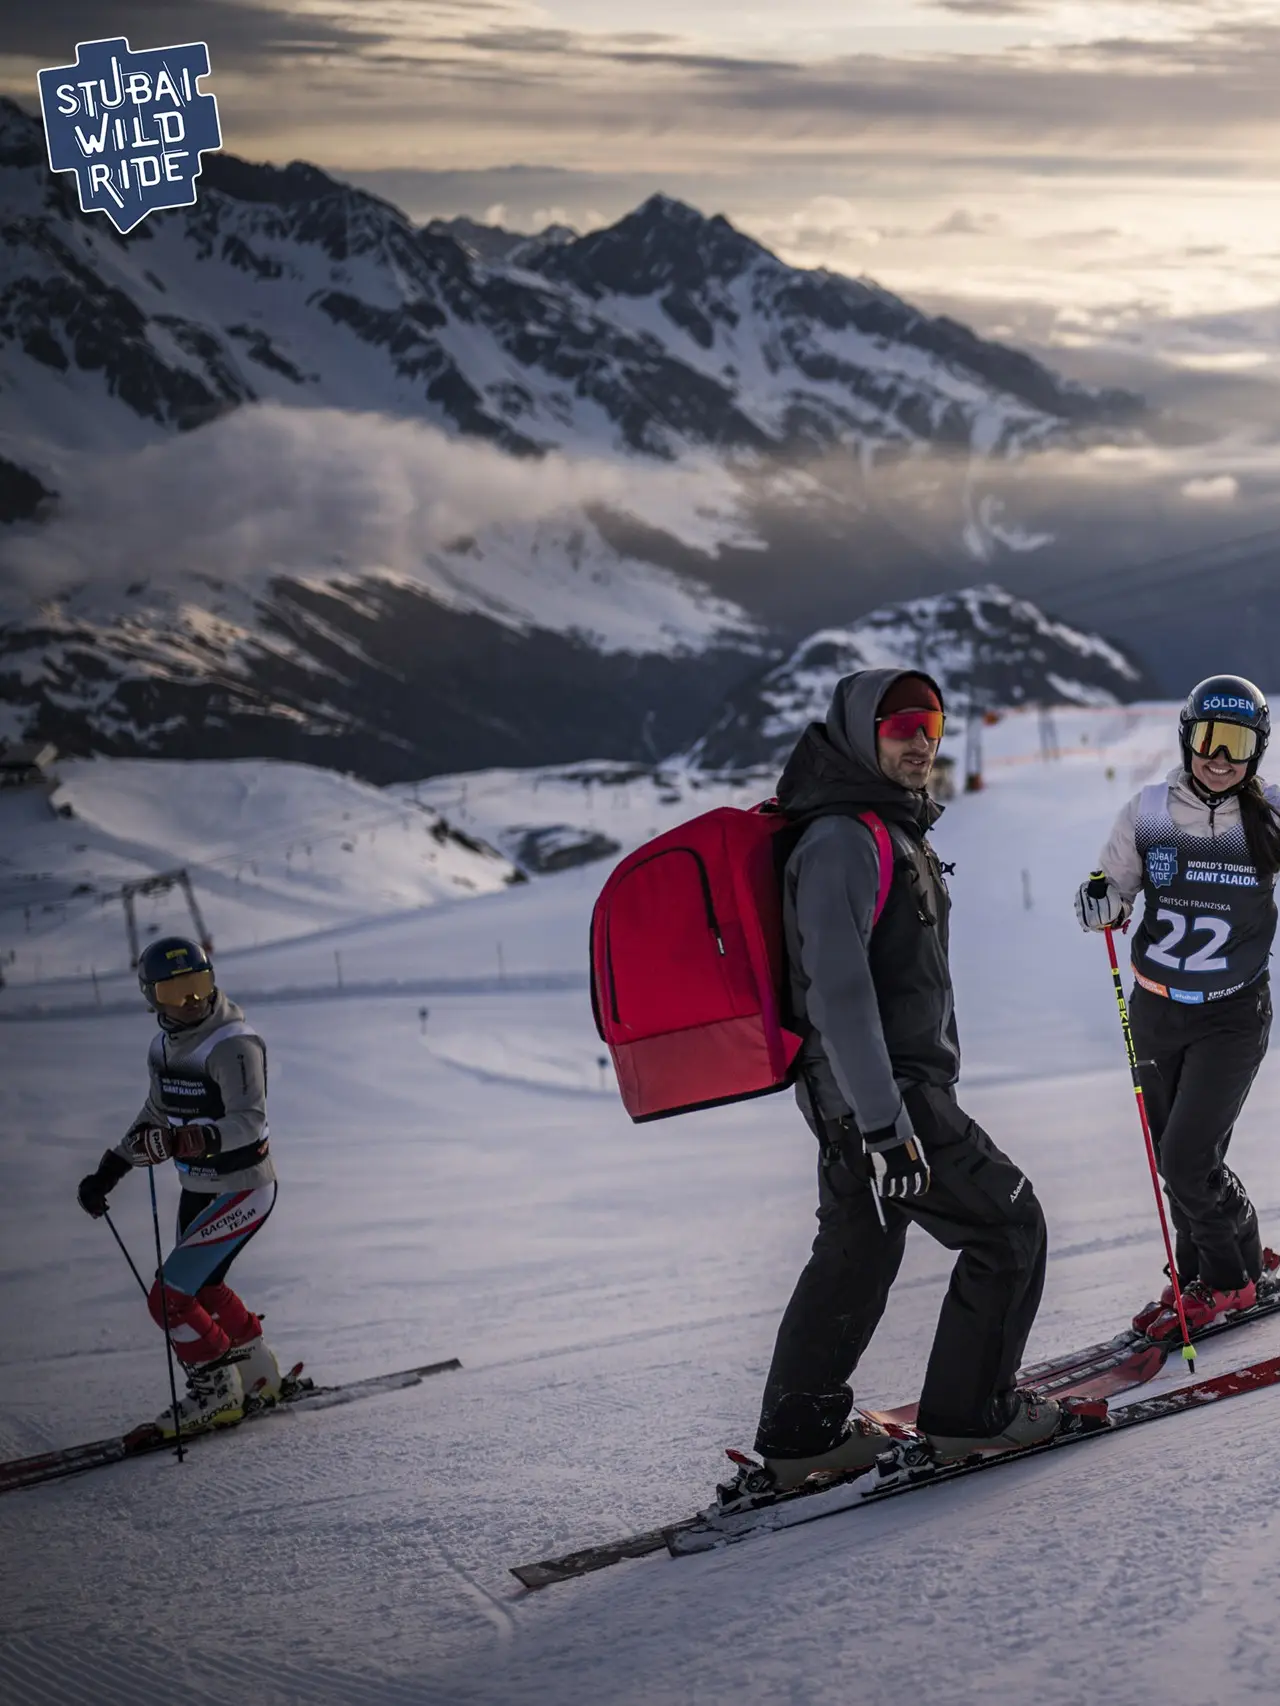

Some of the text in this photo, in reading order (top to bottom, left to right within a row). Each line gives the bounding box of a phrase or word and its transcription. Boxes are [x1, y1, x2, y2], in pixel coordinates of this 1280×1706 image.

[1203, 696, 1254, 712] SÖLDEN
[1150, 861, 1170, 871] WILD
[1187, 860, 1223, 871] WORLD'S
[1151, 871, 1170, 883] RIDE
[1185, 870, 1219, 882] GIANT
[1159, 896, 1232, 912] GRITSCH FRANZISKA
[1145, 908, 1232, 971] 22
[1115, 986, 1129, 1027] LEKI
[200, 1209, 243, 1239] RACING
[229, 1208, 257, 1232] TEAM
